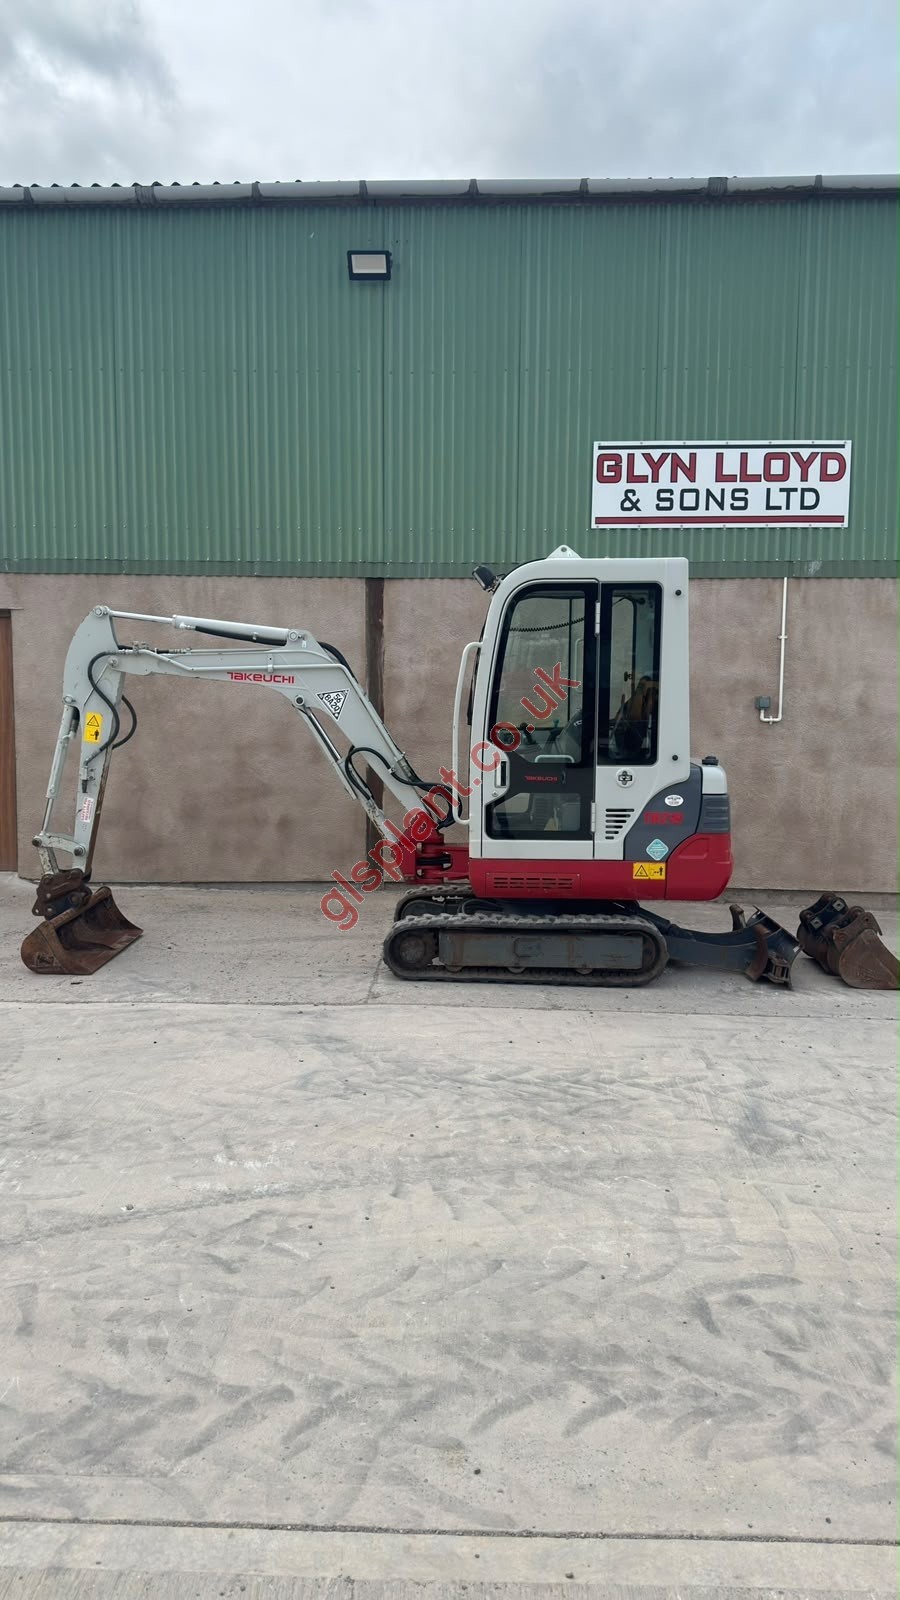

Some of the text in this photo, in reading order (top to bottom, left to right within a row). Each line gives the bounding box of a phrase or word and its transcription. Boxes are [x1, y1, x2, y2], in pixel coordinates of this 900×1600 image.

[596, 451, 847, 484] GLYN LLOYD
[620, 487, 821, 512] & SONS LTD
[333, 693, 343, 704] 56
